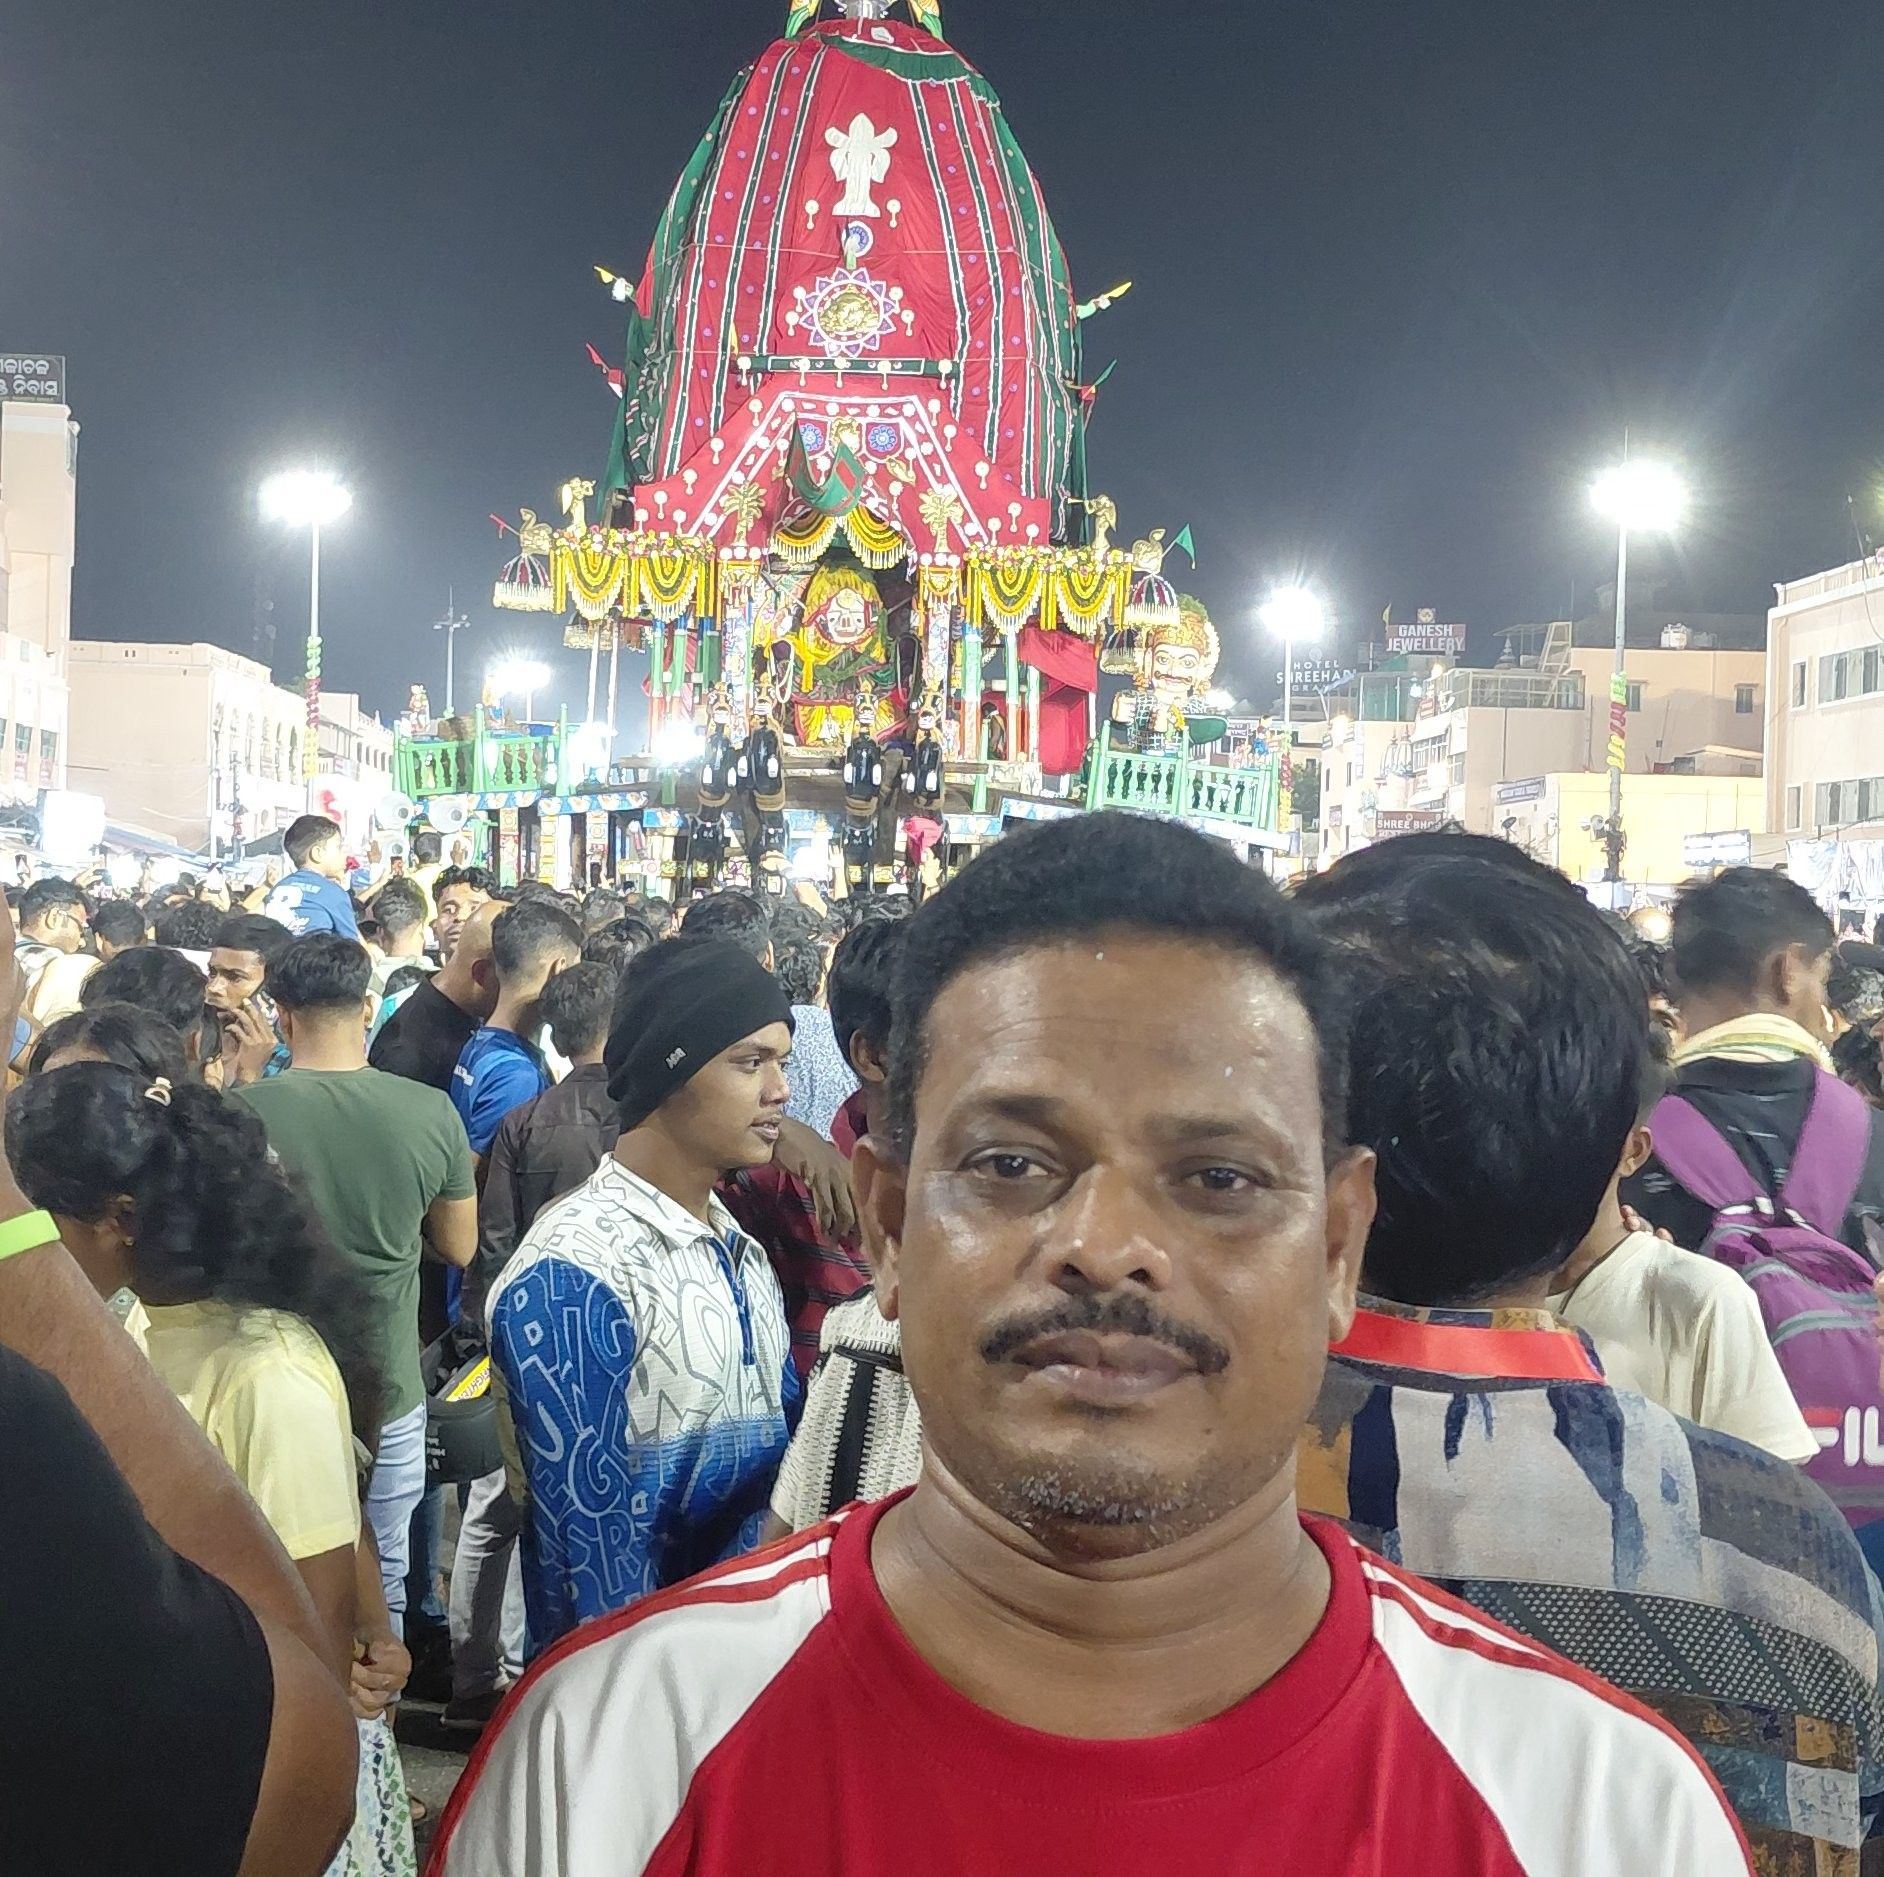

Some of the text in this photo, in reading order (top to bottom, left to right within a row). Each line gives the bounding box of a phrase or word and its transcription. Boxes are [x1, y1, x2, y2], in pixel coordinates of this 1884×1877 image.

[1398, 624, 1453, 637] GANESH
[1387, 637, 1466, 651] JEWELLERY
[1293, 660, 1340, 670] HOTEL
[1377, 819, 1410, 829] SHREE
